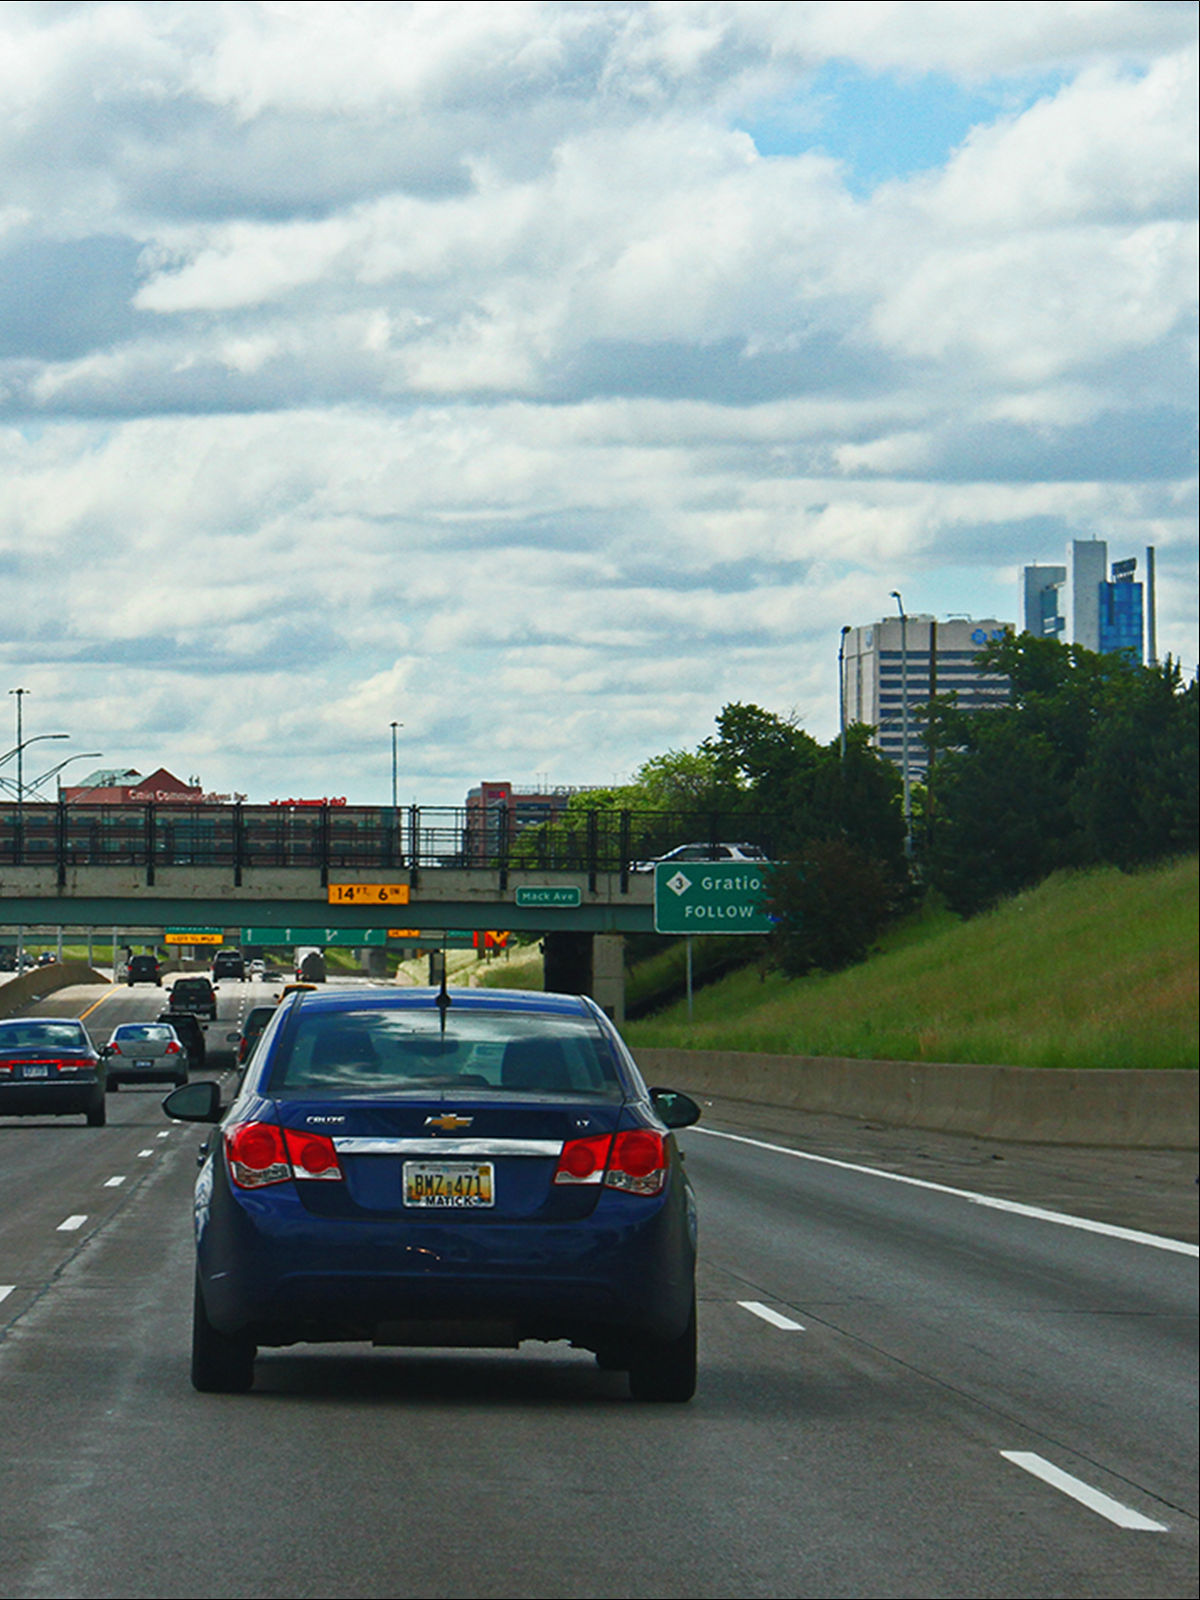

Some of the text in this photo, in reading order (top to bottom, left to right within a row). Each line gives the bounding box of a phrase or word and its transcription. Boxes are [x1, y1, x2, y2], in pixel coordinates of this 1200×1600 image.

[674, 876, 767, 890] 3 Gratio
[337, 886, 355, 901] 14
[378, 887, 388, 901] 6
[522, 891, 575, 901] Mack Ave
[684, 905, 755, 918] FOLLOW
[415, 1175, 483, 1196] BMZ 471
[425, 1196, 474, 1206] MATICK
